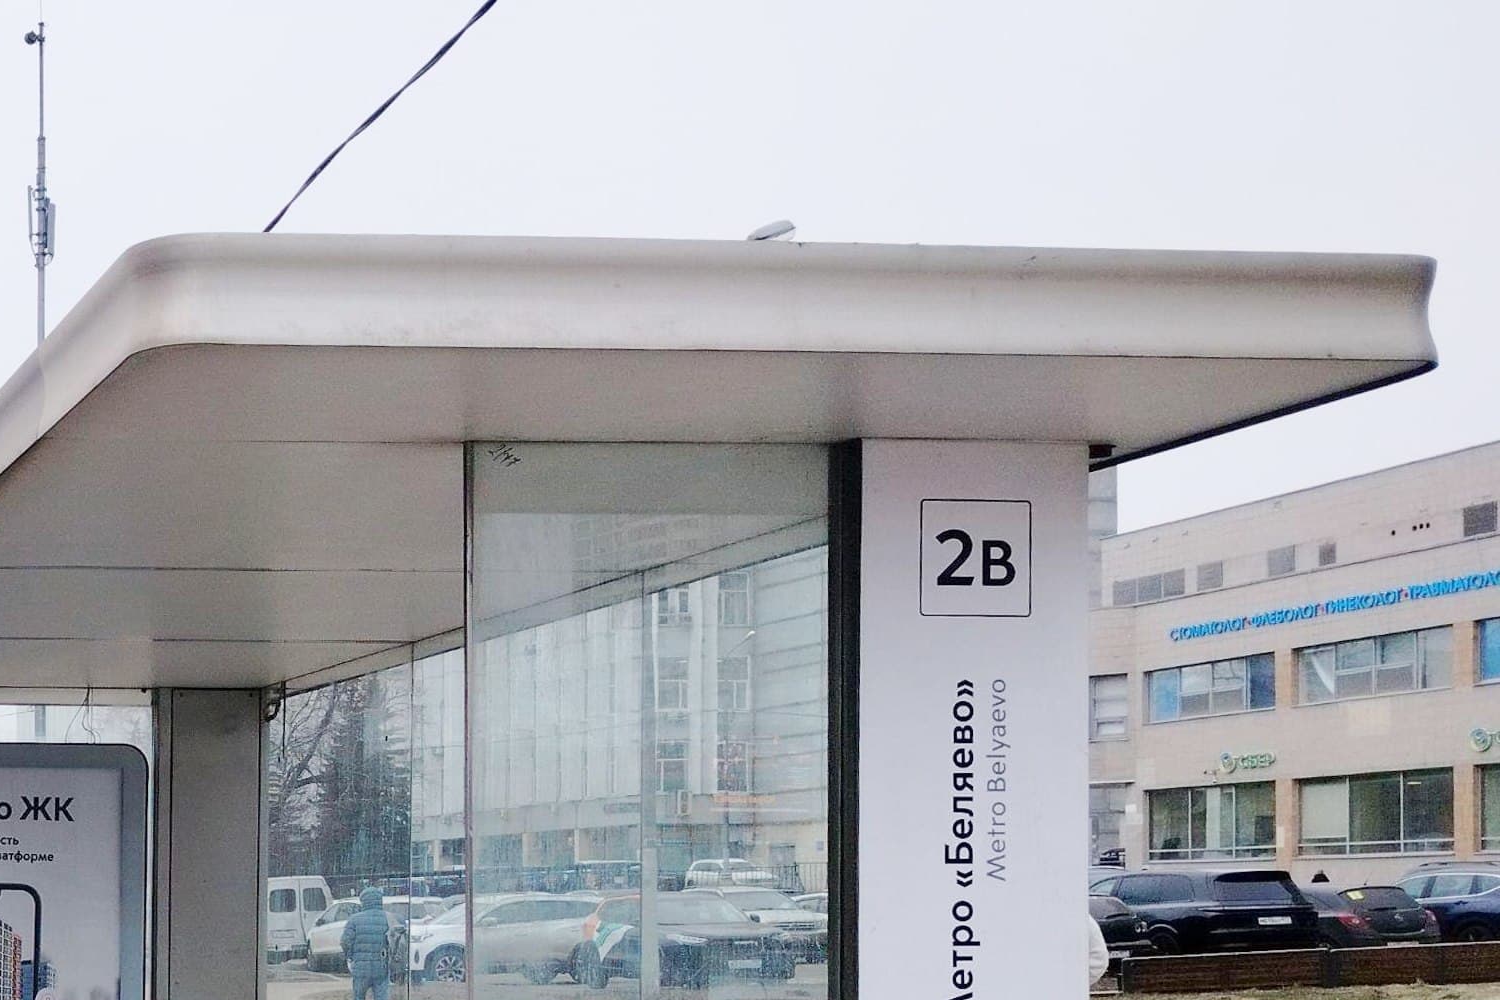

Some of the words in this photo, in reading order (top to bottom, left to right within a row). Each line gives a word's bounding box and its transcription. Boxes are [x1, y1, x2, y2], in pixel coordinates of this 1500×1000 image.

[1170, 616, 1247, 642] СТОМАТОЛОГ
[1251, 603, 1320, 628] ФЛЕБОЛОГ
[1324, 588, 1404, 614] ГИНЕКОЛОГ
[985, 678, 1012, 793] Belyaevo
[19, 795, 75, 822] ЖК
[944, 678, 975, 888] «Беляево»
[985, 801, 1007, 882] Metro
